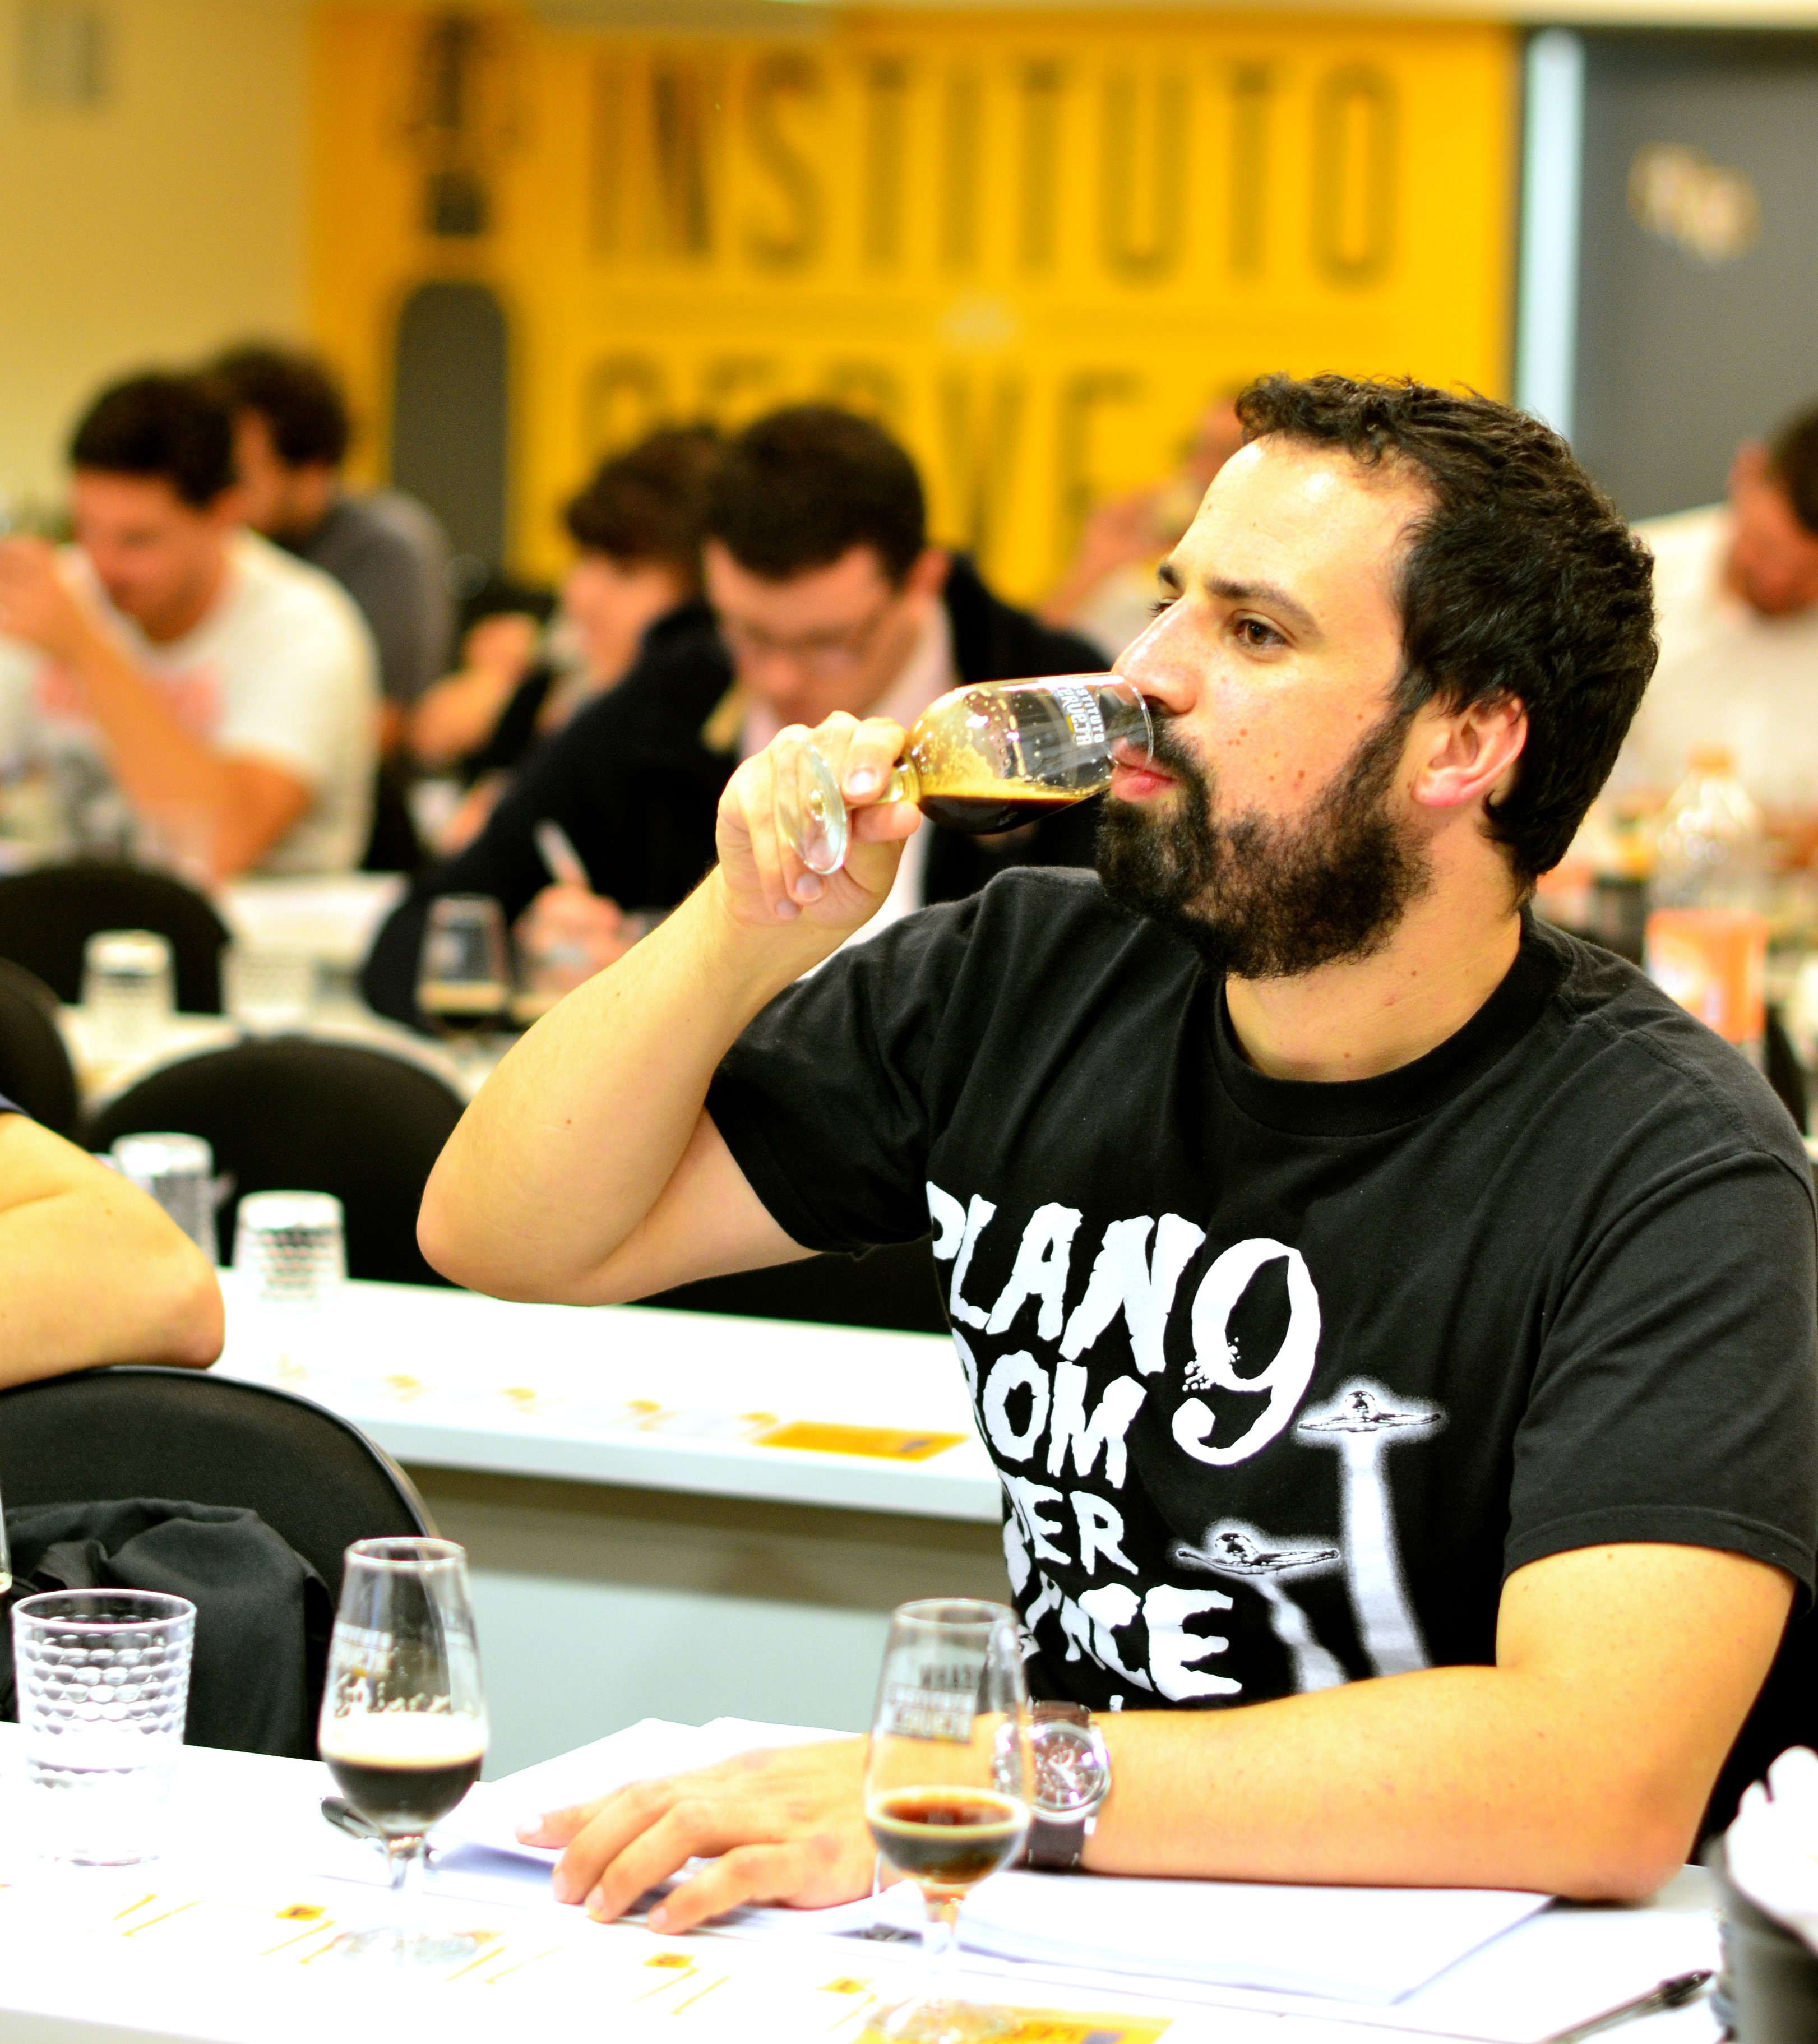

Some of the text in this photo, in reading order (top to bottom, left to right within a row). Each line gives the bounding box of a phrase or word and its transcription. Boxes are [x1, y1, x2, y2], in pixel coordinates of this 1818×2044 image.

[586, 52, 1398, 286] INSTITUTO
[927, 1181, 1321, 1467] PLAN 9
